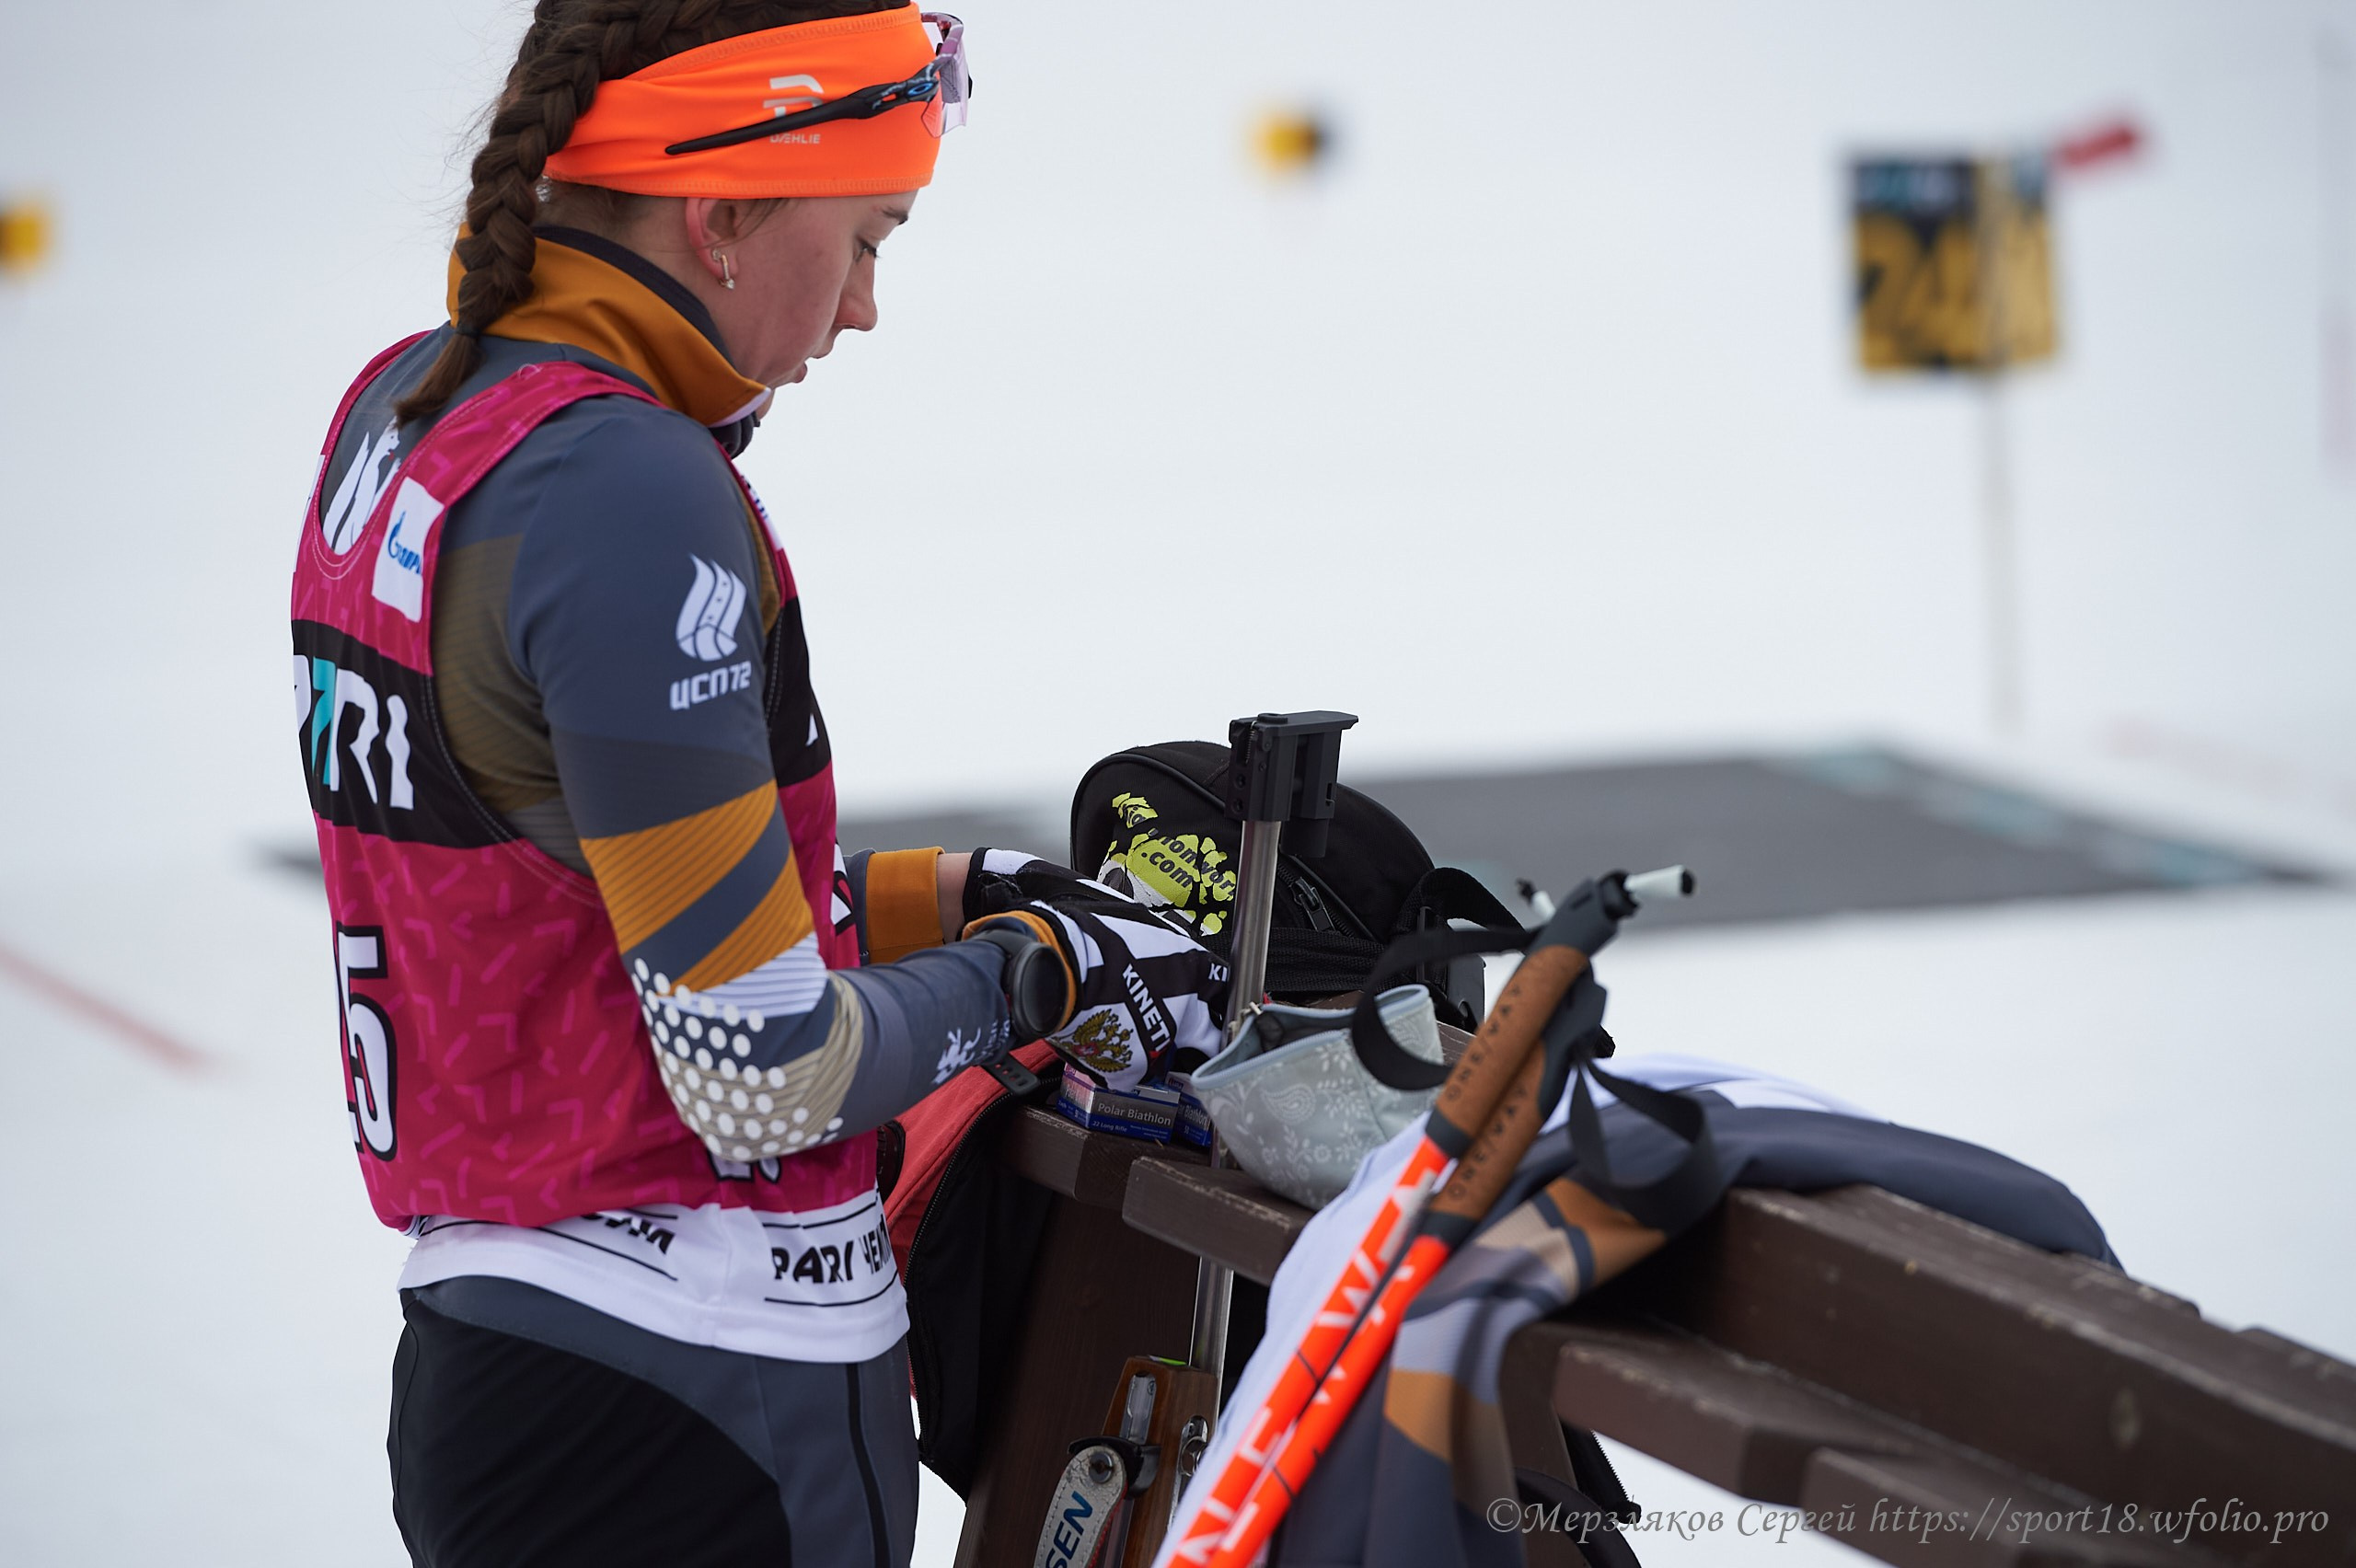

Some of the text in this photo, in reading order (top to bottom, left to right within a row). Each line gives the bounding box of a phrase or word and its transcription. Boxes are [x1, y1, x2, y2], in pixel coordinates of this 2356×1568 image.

[1141, 851, 1194, 889] .com
[334, 920, 398, 1162] 5
[1098, 1102, 1125, 1117] Polar
[1127, 1108, 1172, 1126] Biathlon
[771, 1240, 854, 1285] PARI
